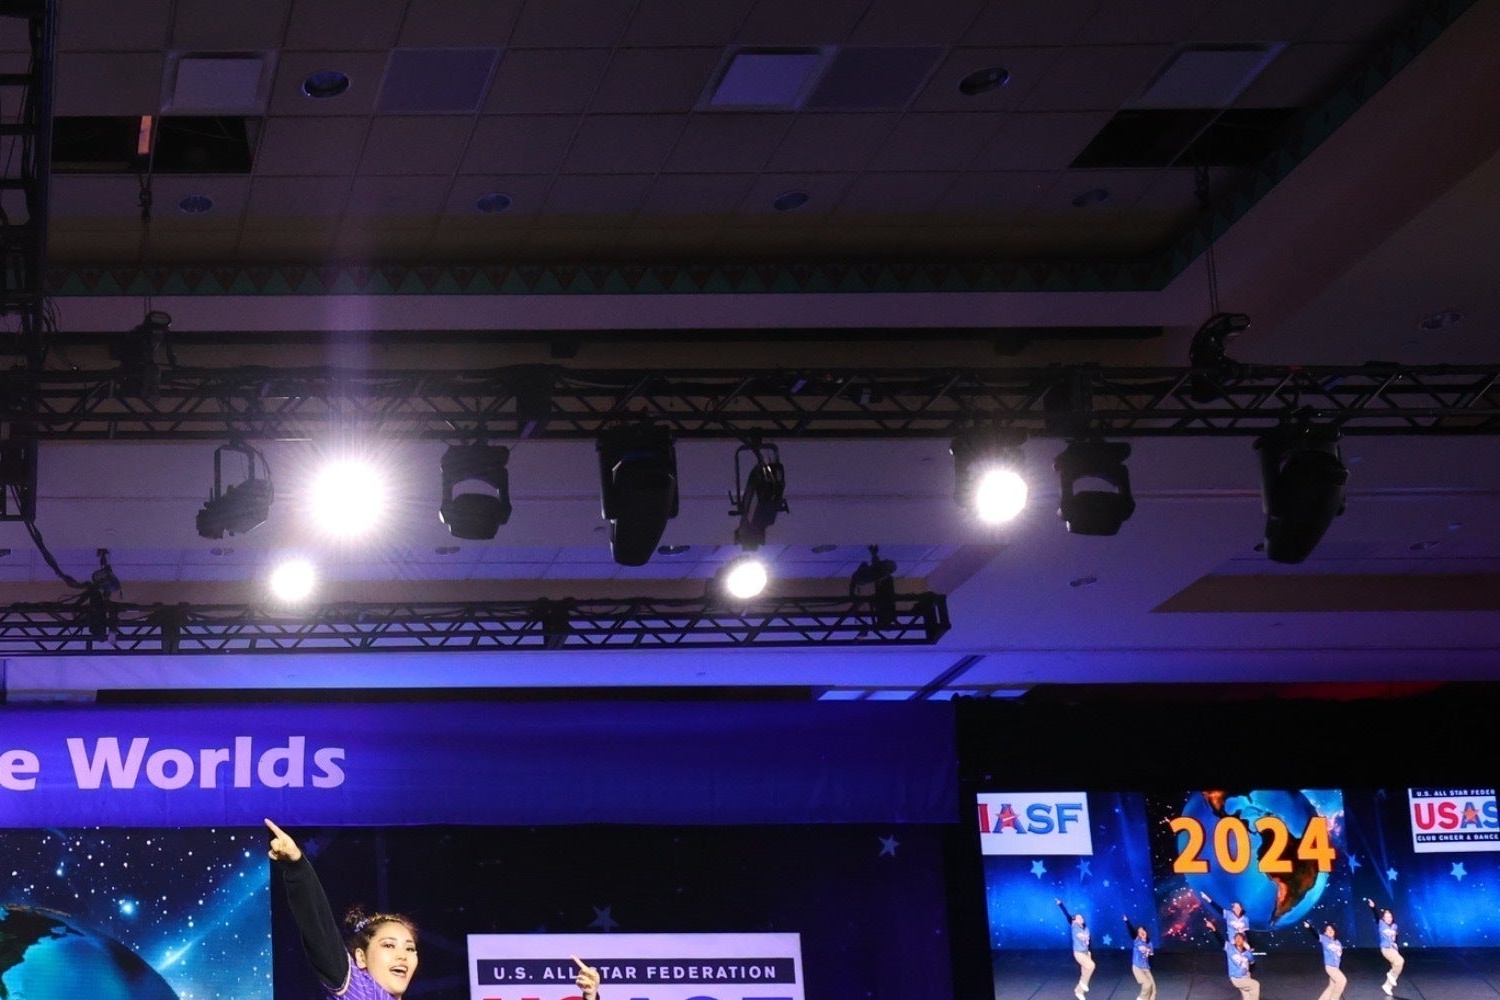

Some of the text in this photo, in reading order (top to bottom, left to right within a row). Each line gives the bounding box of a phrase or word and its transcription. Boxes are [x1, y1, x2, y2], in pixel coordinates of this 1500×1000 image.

[67, 736, 346, 792] Worlds
[977, 803, 1083, 834] IASF
[1414, 801, 1500, 830] USAS
[1170, 816, 1336, 874] 2024
[493, 966, 533, 979] U.S.
[543, 966, 576, 979] ALL
[647, 965, 776, 979] FEDERATION
